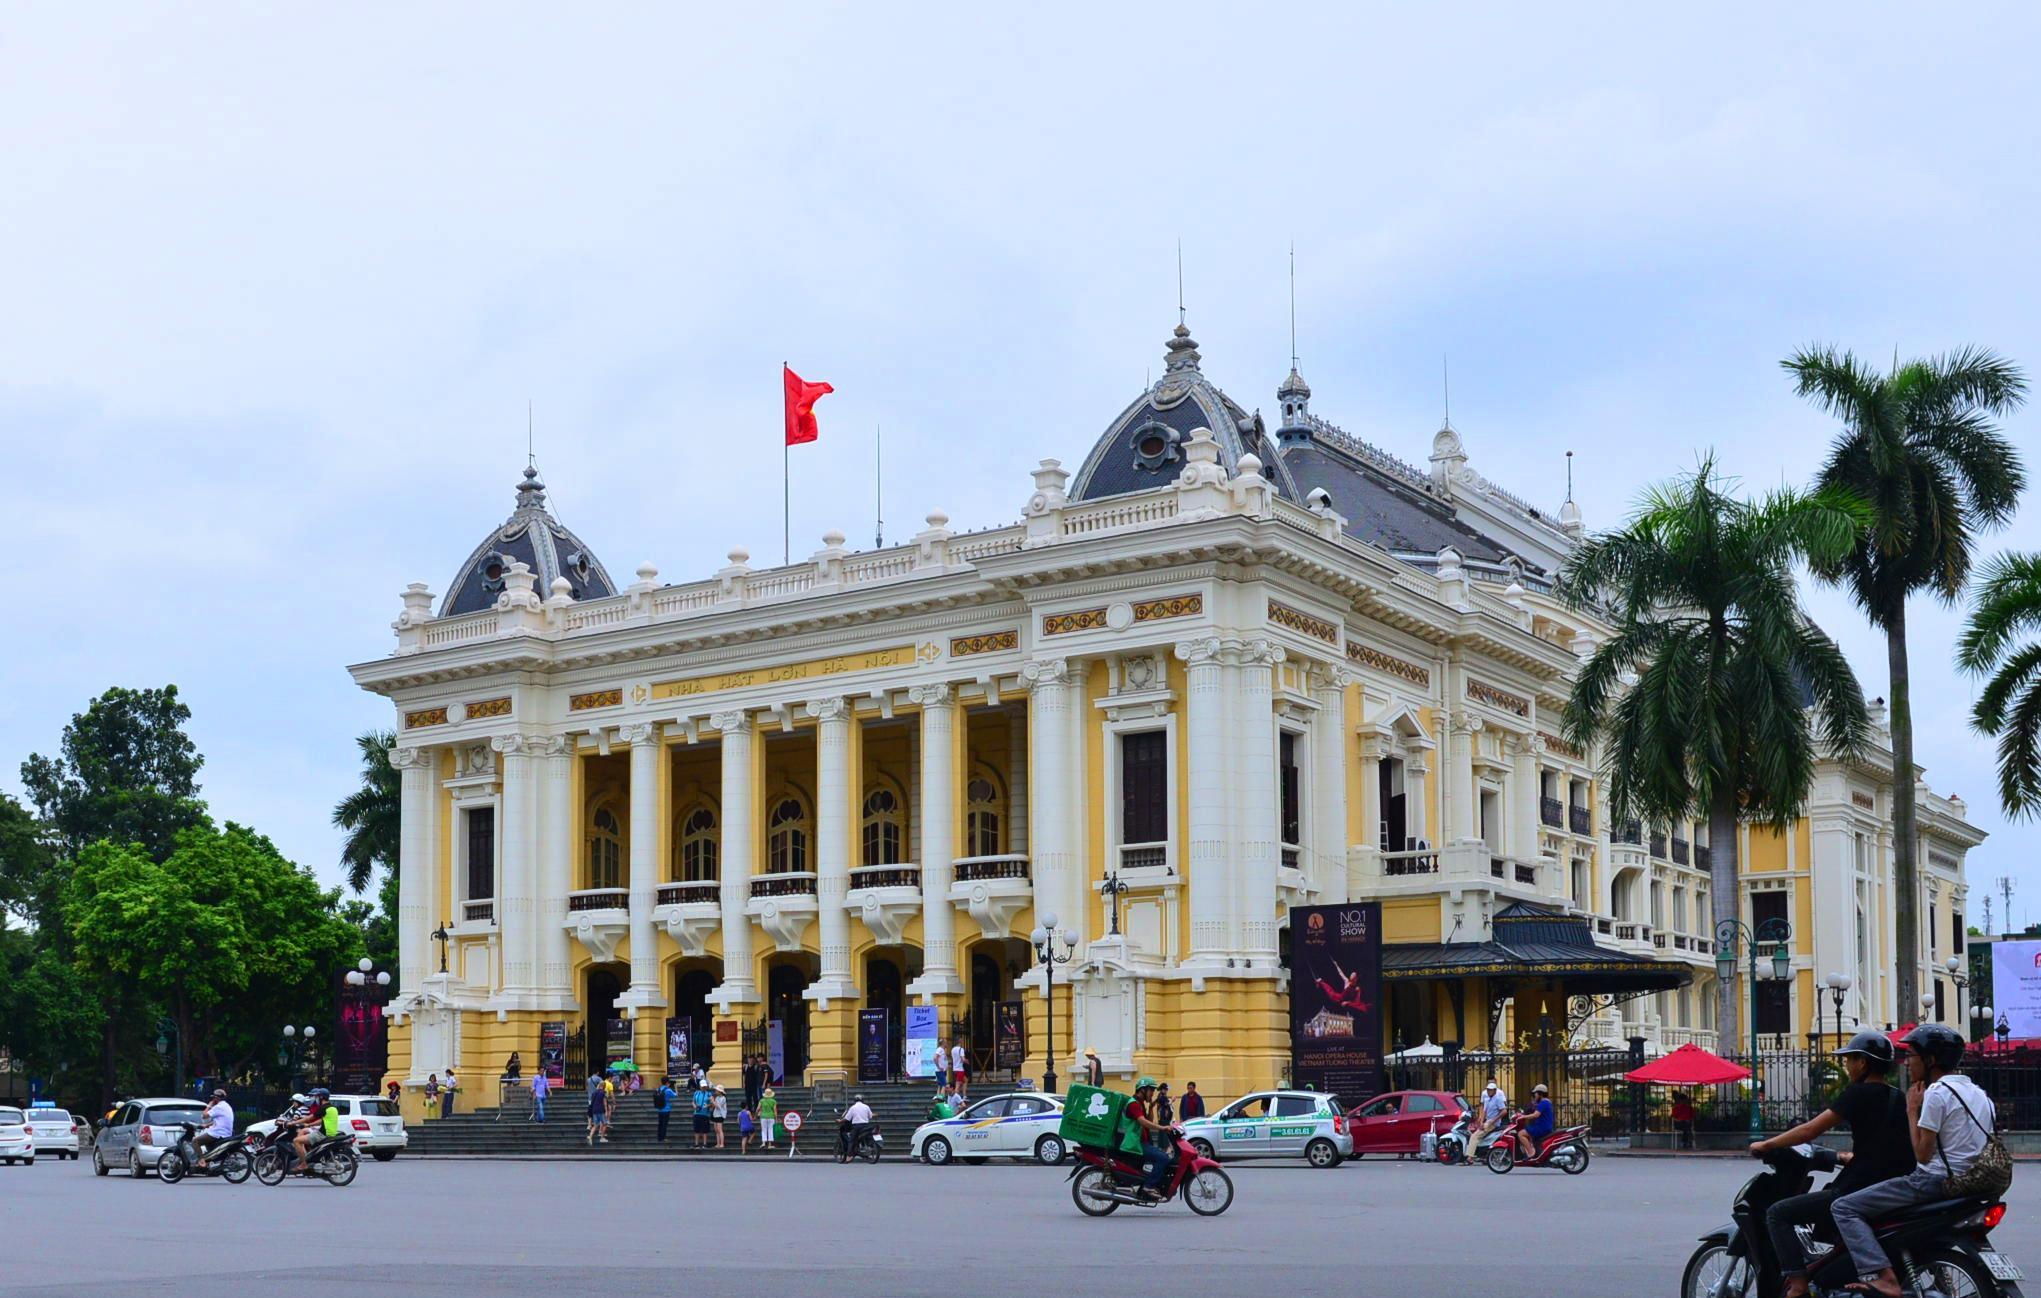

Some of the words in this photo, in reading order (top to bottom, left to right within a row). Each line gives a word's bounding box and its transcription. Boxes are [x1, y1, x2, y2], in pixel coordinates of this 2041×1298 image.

[669, 679, 705, 697] NHÀ
[822, 656, 848, 674] HÀ
[1340, 911, 1366, 923] NO.1
[1341, 928, 1366, 936] SHOW
